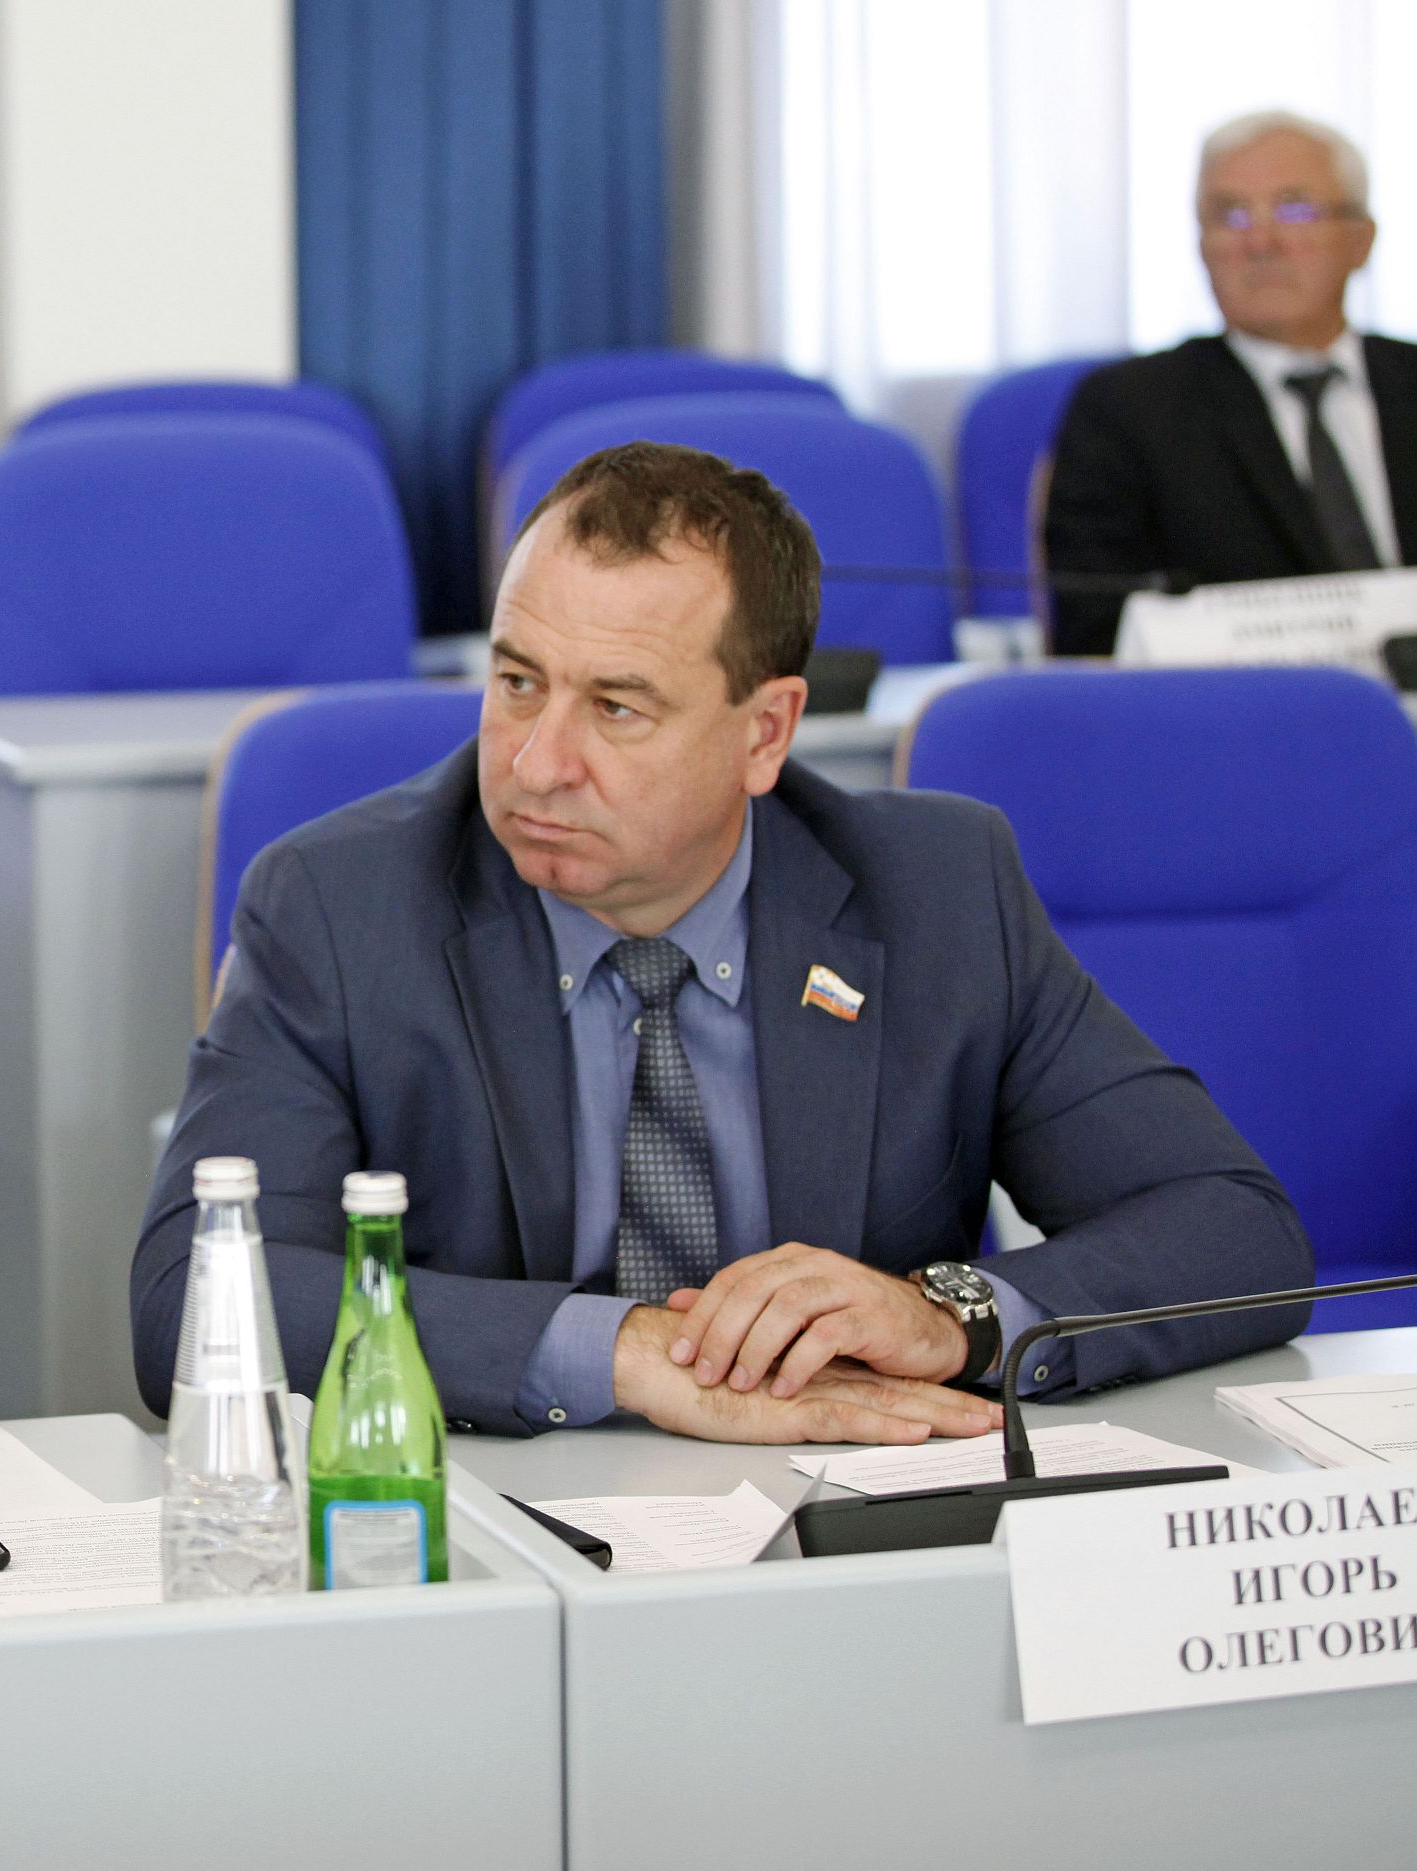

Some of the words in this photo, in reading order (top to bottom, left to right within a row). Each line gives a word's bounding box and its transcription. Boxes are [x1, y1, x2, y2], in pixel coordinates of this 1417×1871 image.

[1165, 1487, 1417, 1549] НИКОЛАЕ
[1231, 1554, 1399, 1606] ИГОРЬ
[1178, 1613, 1417, 1673] ОЛЕГОВИ
